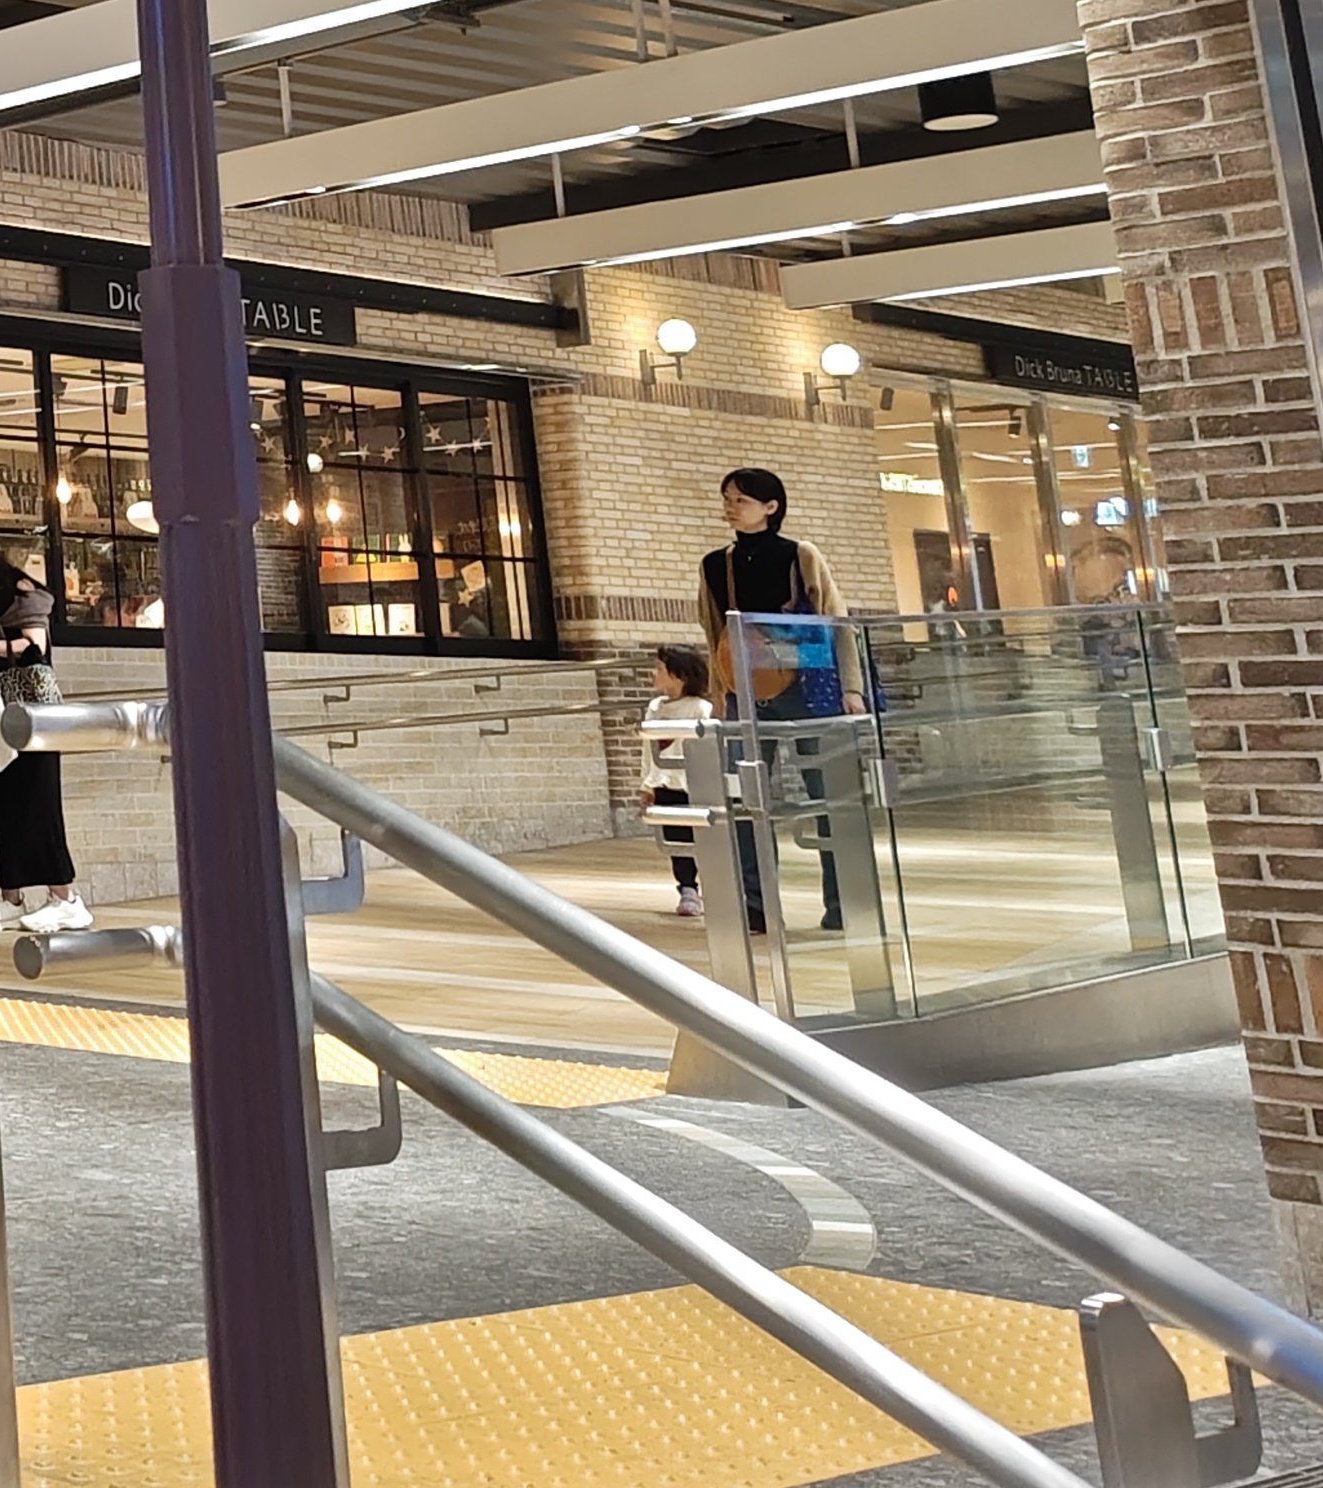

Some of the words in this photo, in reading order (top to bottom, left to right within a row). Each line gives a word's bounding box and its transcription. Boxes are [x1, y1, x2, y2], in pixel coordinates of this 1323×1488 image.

[108, 281, 143, 312] Dic
[241, 298, 323, 335] TABLE
[1014, 355, 1045, 379] Dick
[1046, 360, 1082, 384] Bruna
